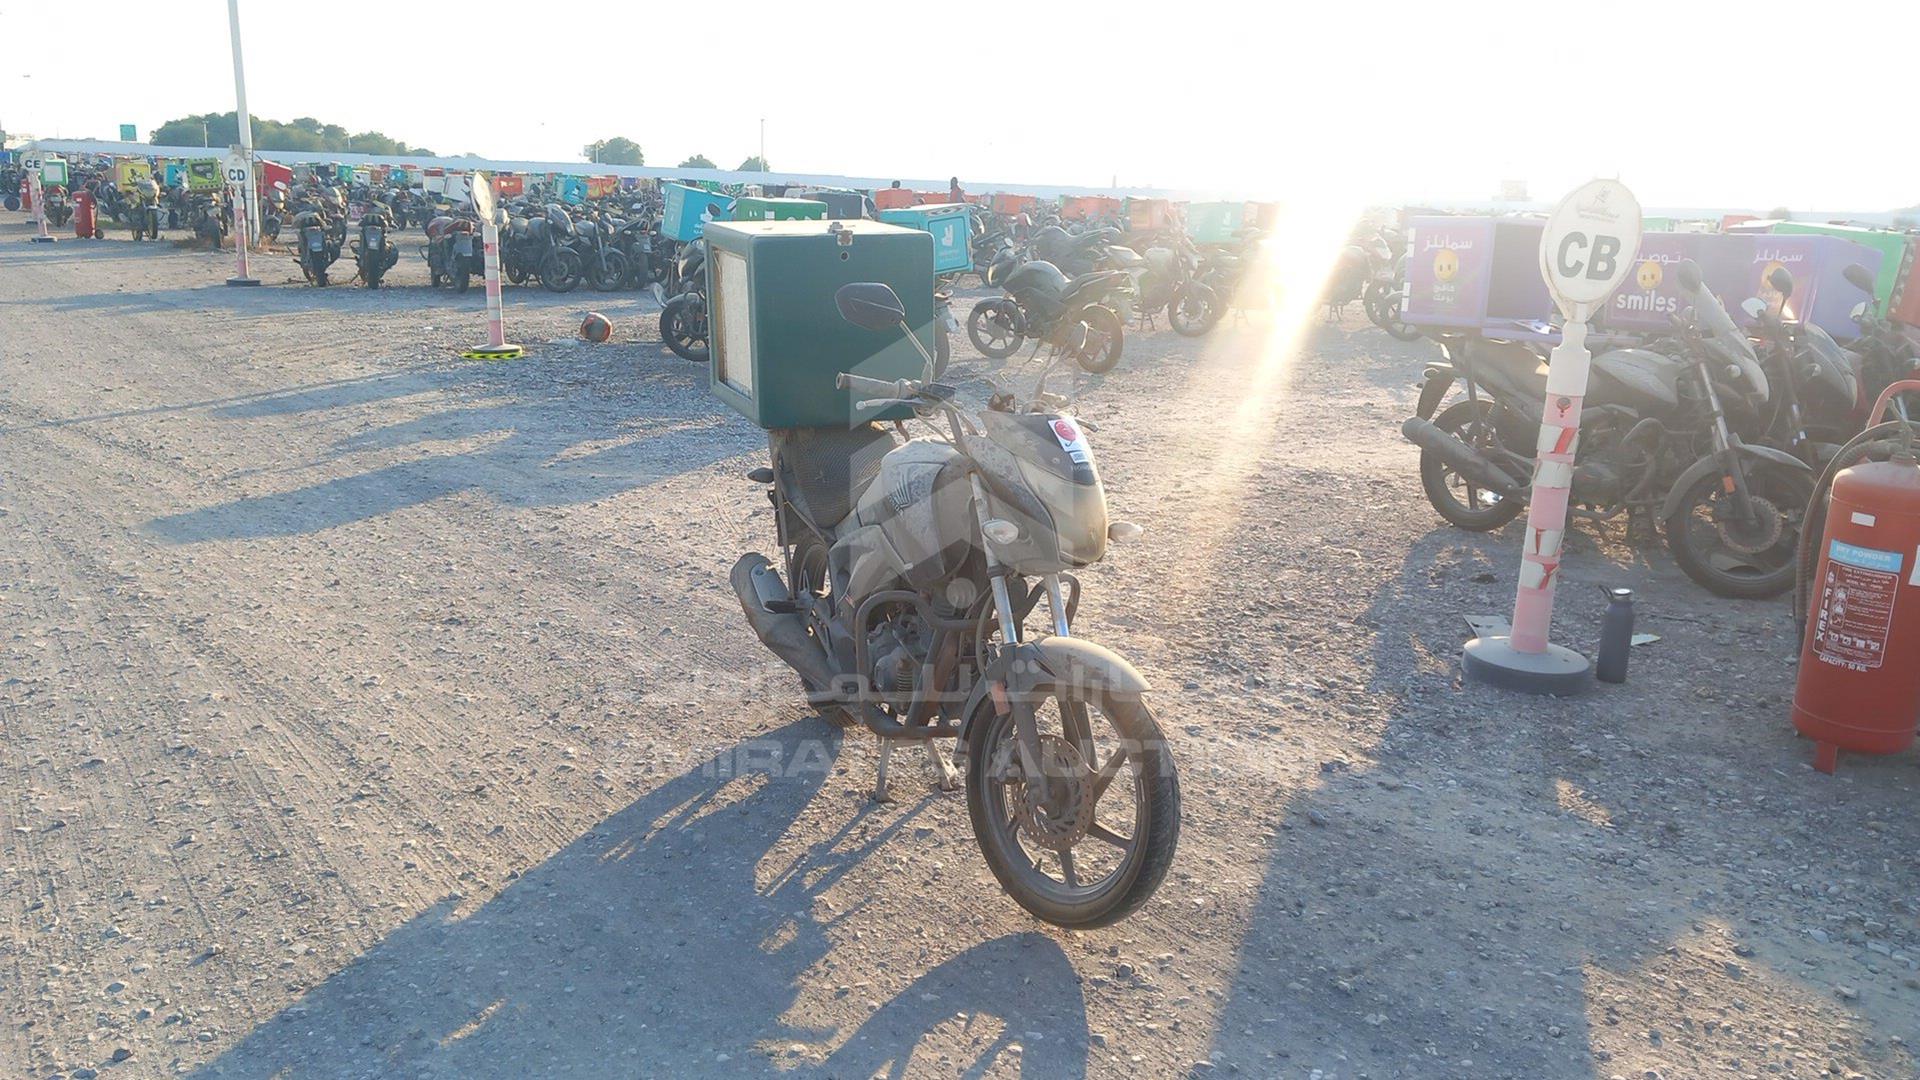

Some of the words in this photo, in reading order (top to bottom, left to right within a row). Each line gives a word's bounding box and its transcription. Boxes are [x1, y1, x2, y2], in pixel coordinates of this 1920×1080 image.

[25, 159, 41, 169] CE
[228, 168, 246, 182] CD
[1557, 231, 1621, 281] CB
[1616, 289, 1677, 313] smiles
[1816, 587, 1832, 641] FIREX
